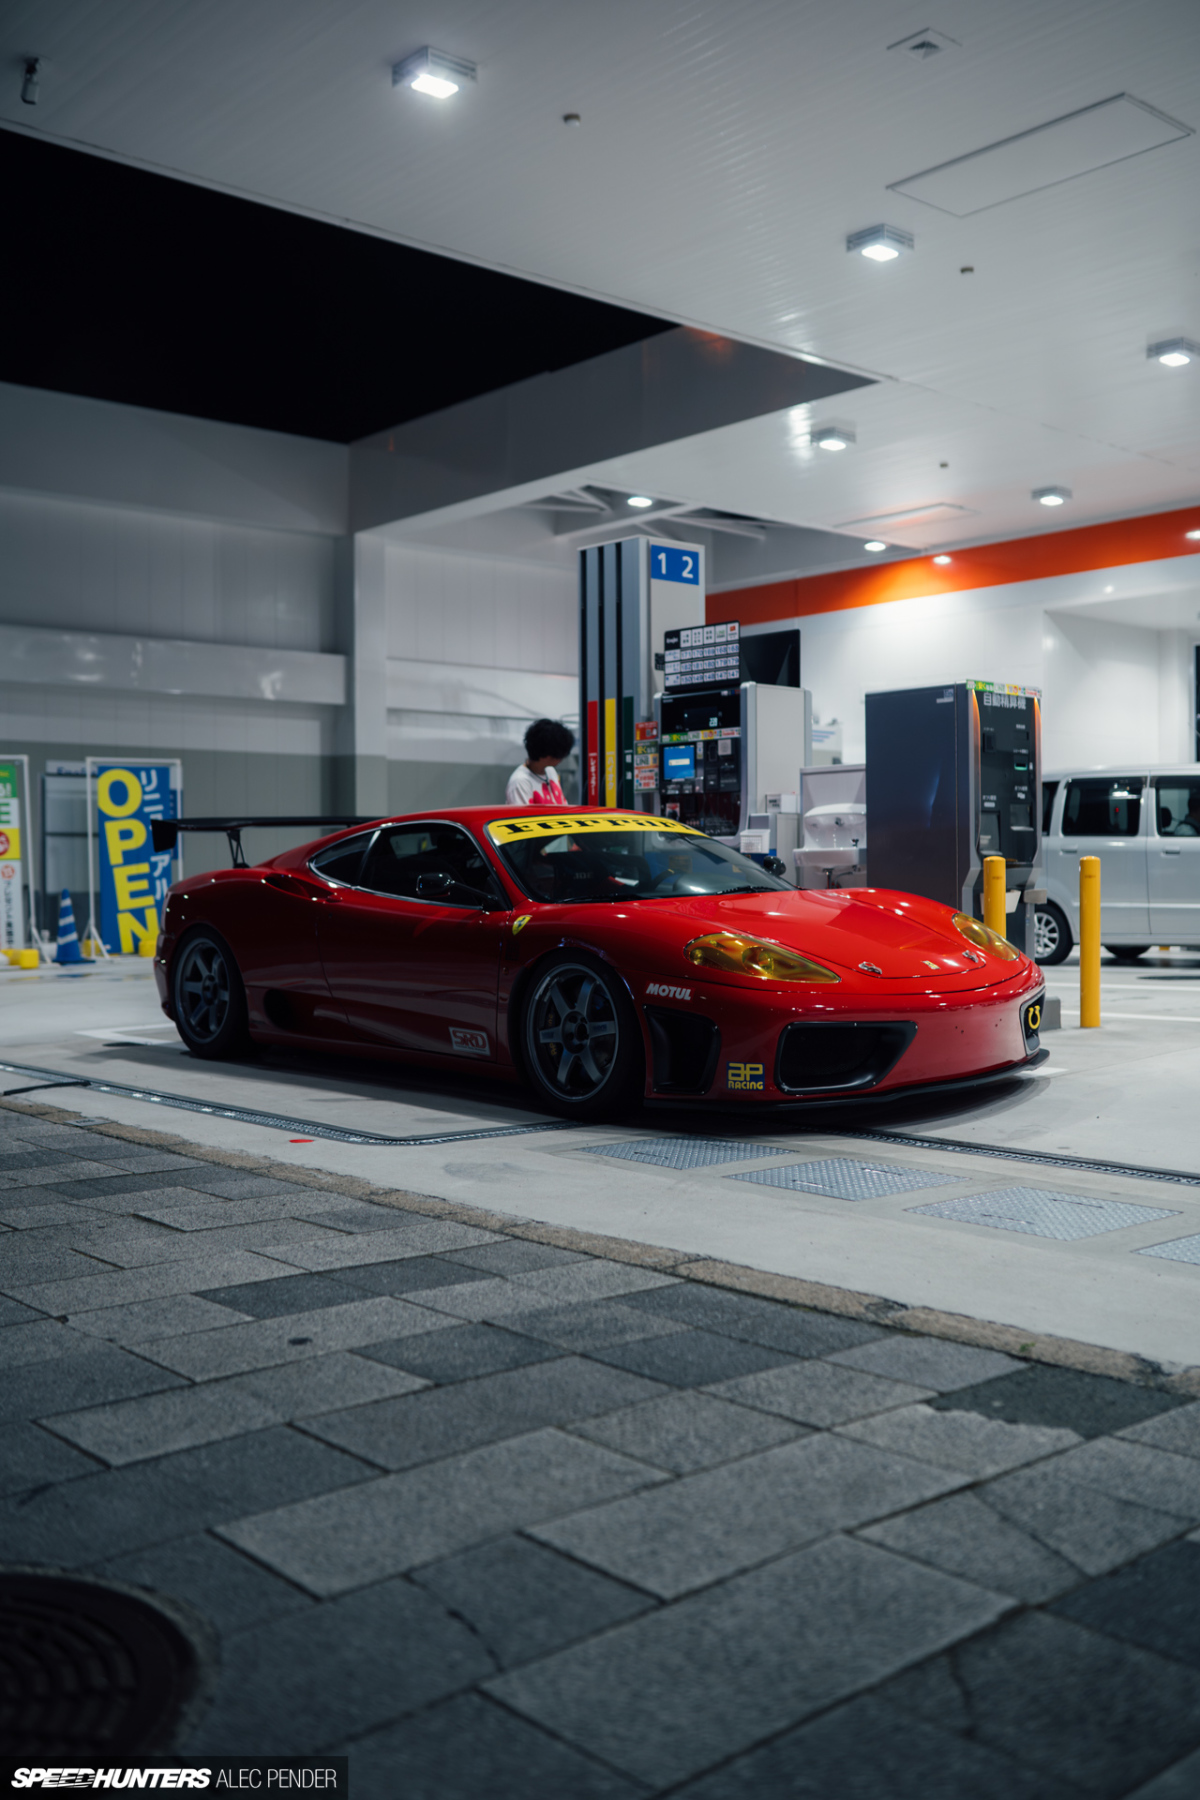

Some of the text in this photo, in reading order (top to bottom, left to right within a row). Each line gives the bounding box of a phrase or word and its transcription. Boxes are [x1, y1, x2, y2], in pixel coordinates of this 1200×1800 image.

[657, 552, 694, 579] 1 2
[728, 669, 739, 678] 147
[983, 692, 1026, 710] 自動精算機
[497, 818, 692, 835] Ferrari
[97, 768, 161, 954] OPEN
[645, 982, 692, 1001] MOTUL
[728, 1080, 764, 1090] RACING
